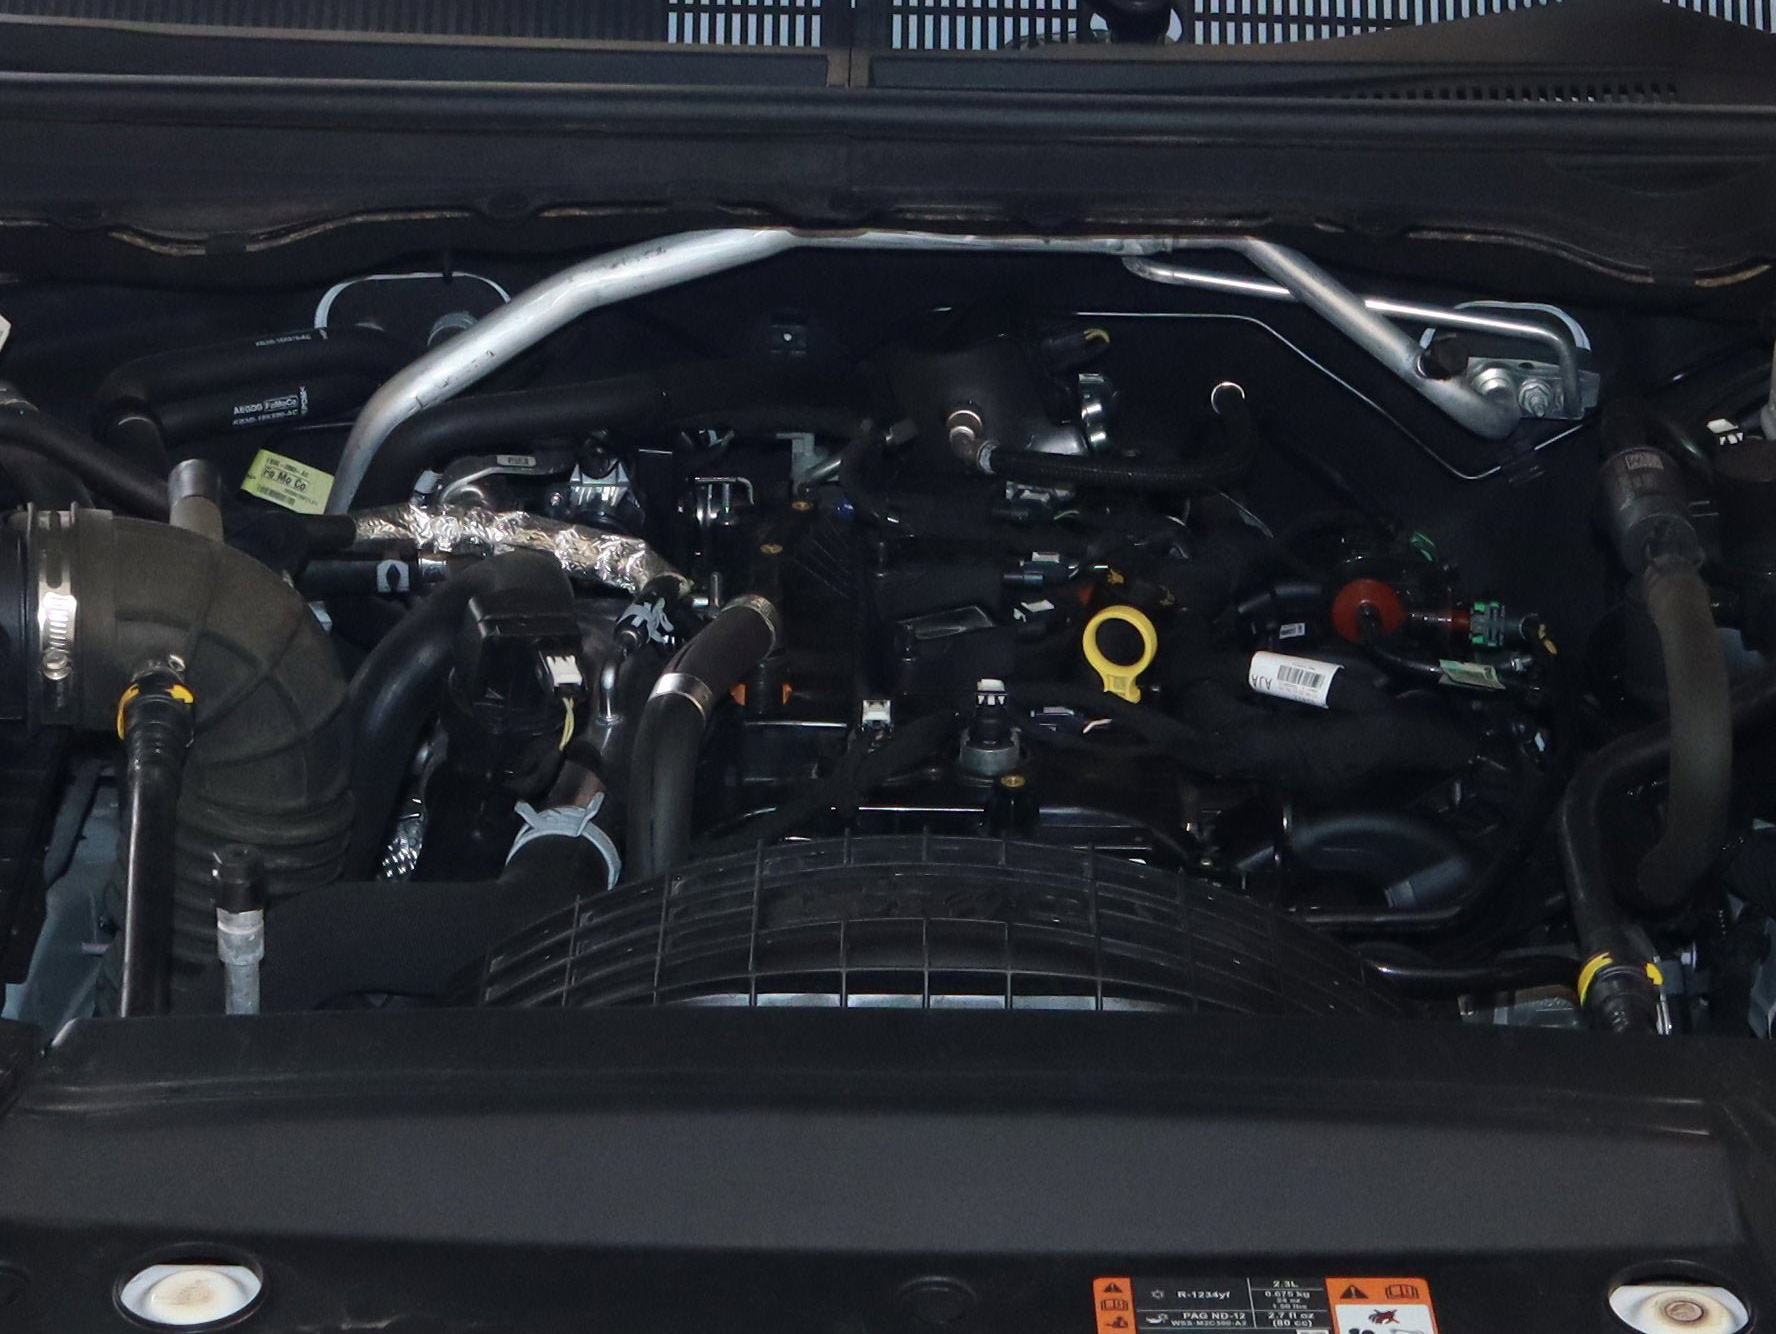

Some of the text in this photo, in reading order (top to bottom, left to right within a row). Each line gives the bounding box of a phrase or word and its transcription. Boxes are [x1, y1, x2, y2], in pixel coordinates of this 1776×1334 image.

[1272, 1280, 1299, 1288] 2.3L
[1177, 1289, 1231, 1301] R-1234yf
[1183, 1312, 1246, 1320] PAG ND-12
[1267, 1311, 1285, 1320] 2.7
